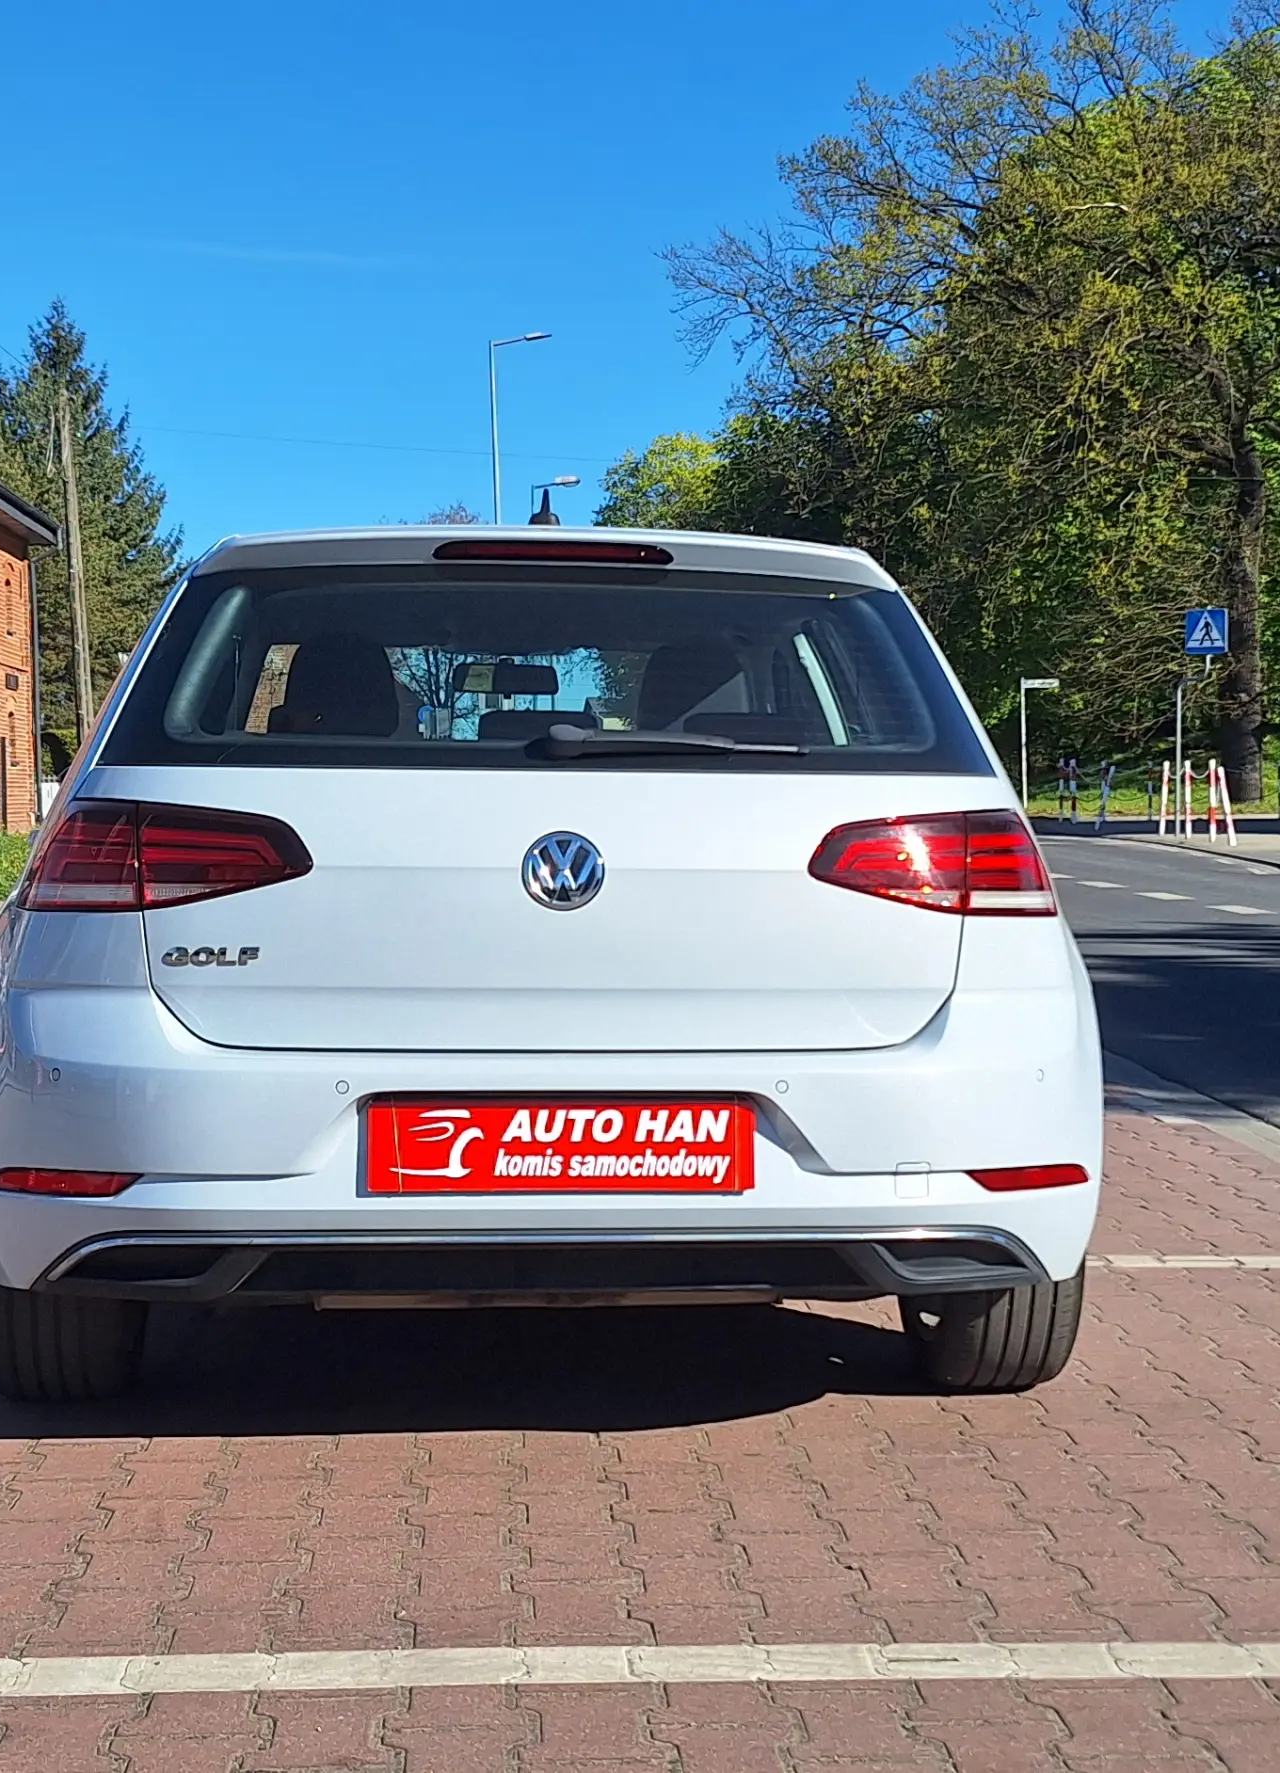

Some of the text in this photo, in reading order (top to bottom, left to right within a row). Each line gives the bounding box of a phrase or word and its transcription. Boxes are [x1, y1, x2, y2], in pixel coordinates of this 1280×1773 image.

[161, 946, 260, 967] GOLF
[501, 1109, 730, 1143] AUTO HAN
[493, 1148, 731, 1184] komis samochodowy
